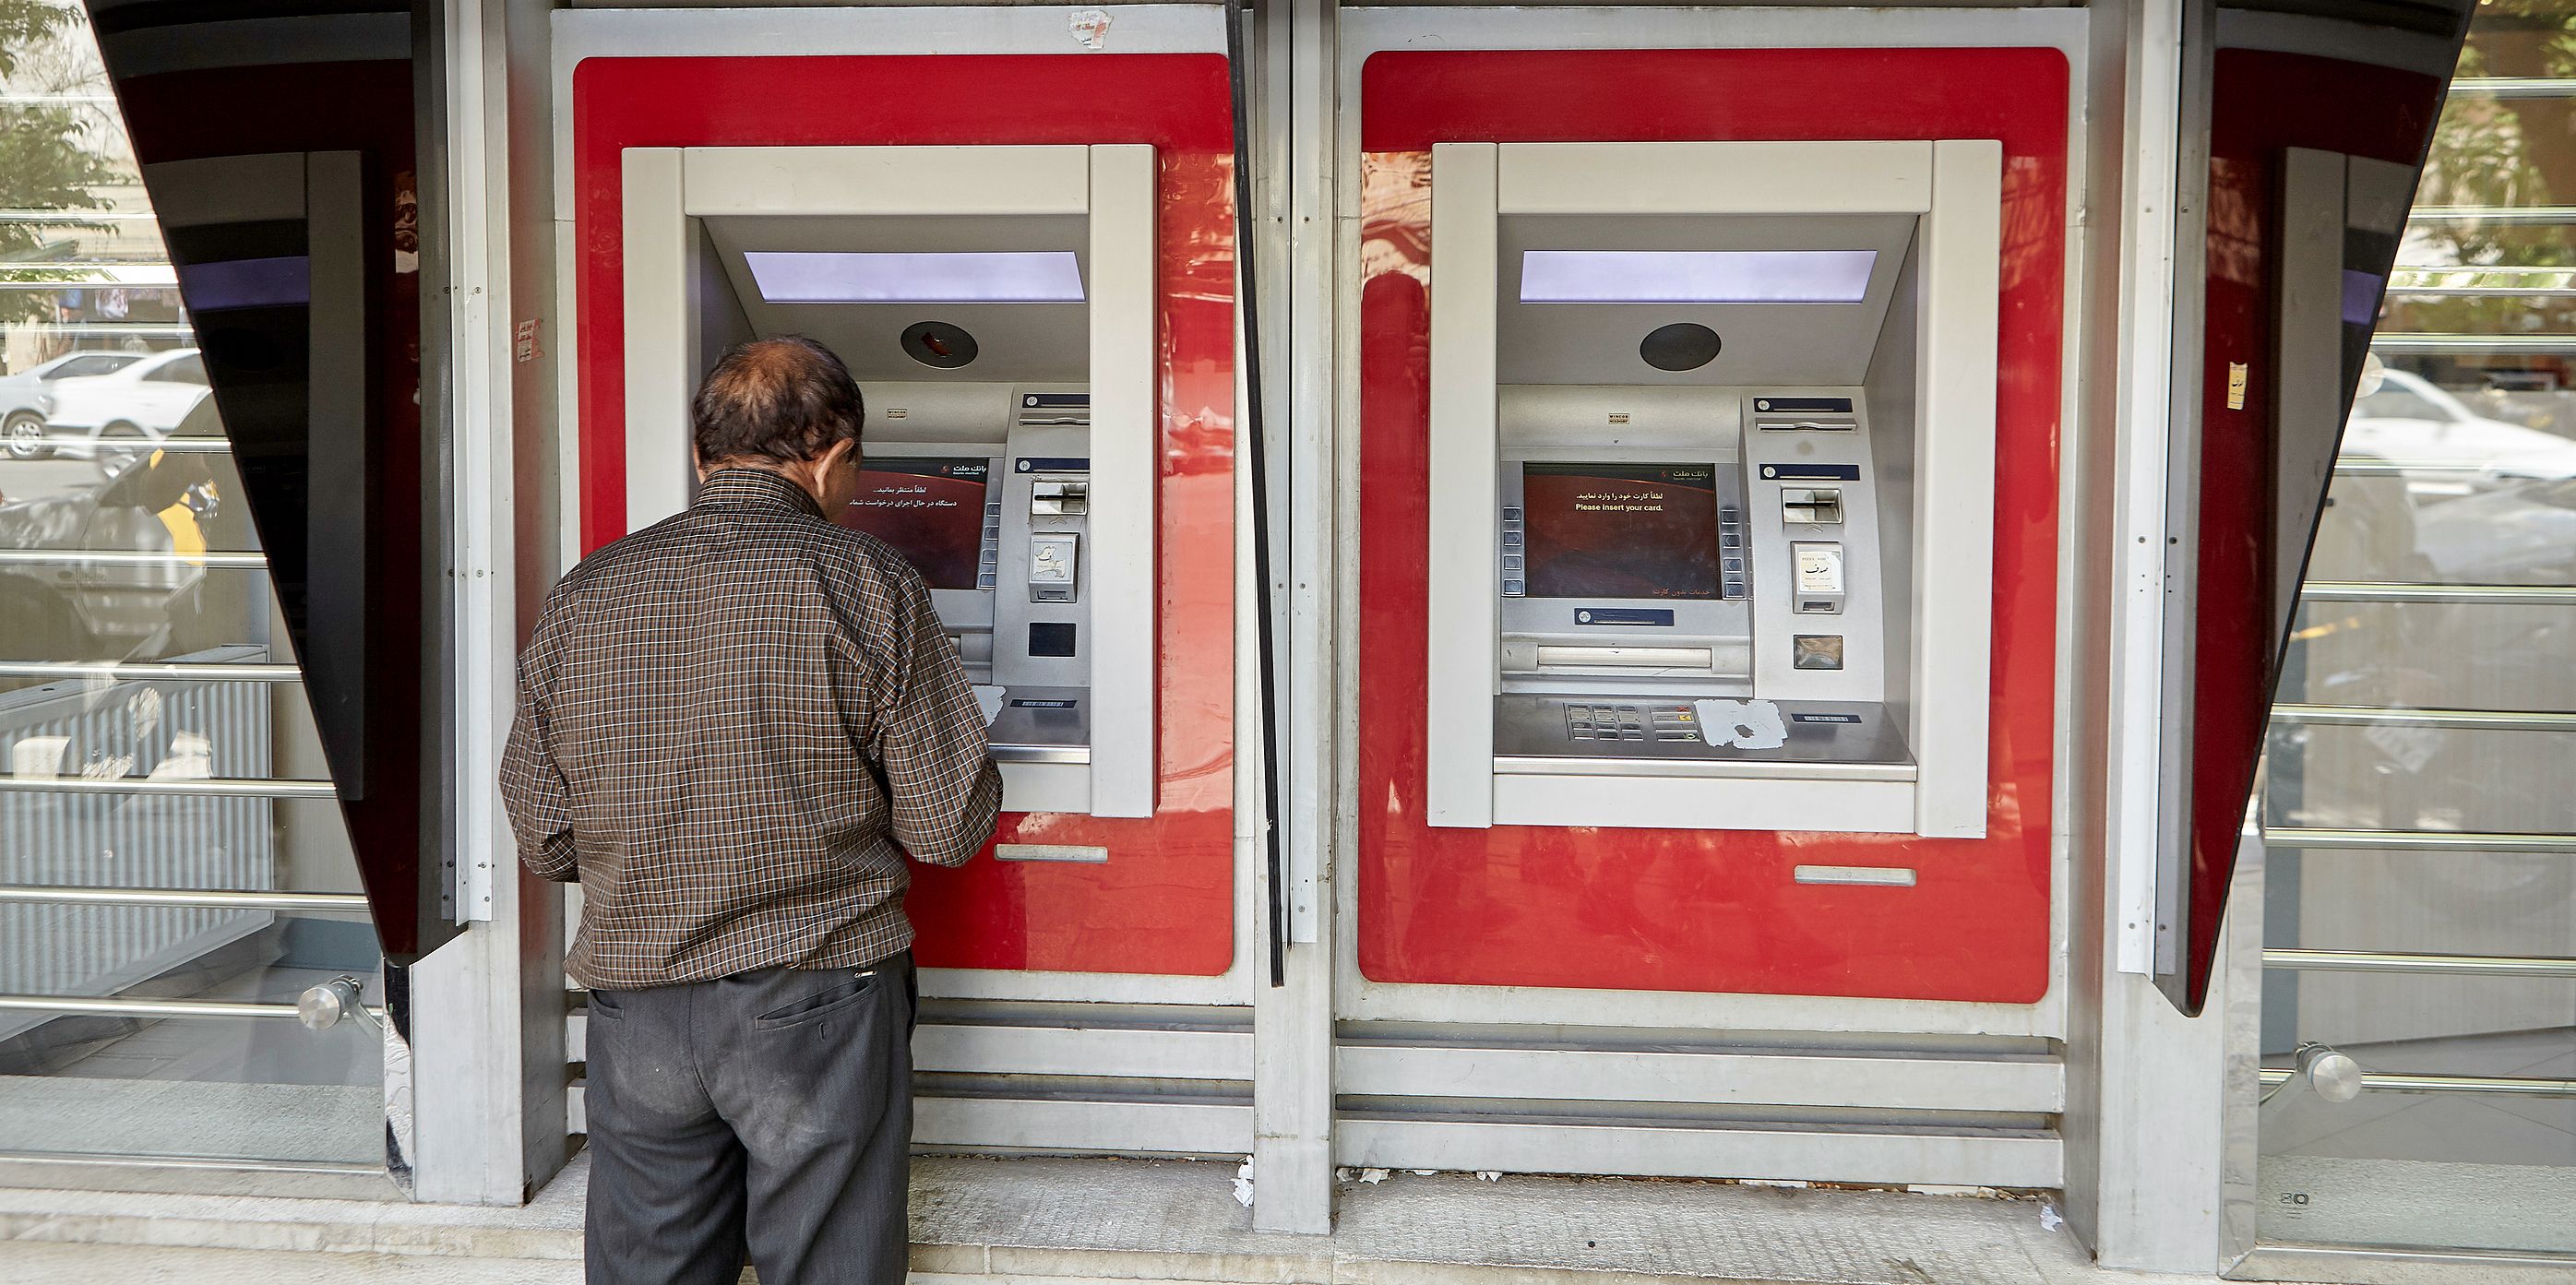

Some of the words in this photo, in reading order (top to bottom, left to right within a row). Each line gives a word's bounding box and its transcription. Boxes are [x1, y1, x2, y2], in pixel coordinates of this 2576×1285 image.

[896, 486, 913, 494] منتظر
[1633, 492, 1649, 500] کارت
[865, 499, 894, 507] درخواست
[913, 500, 925, 508] حال
